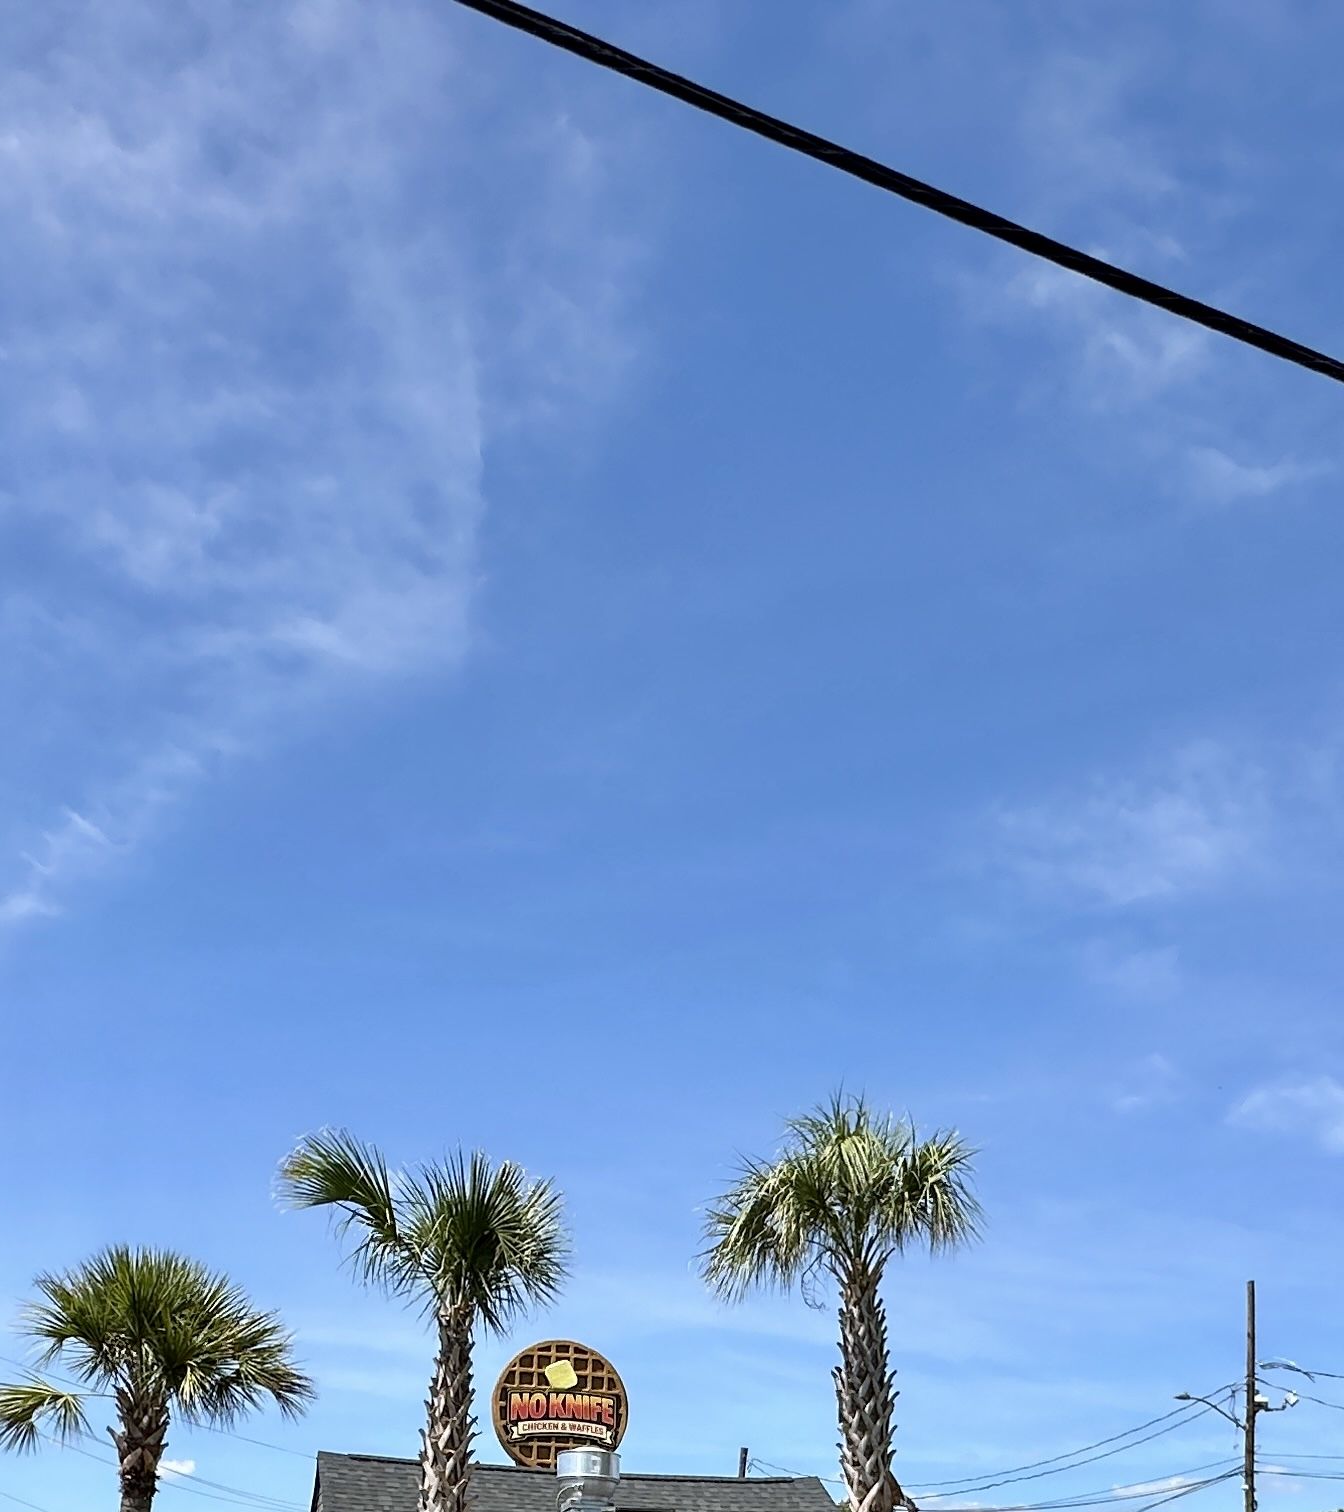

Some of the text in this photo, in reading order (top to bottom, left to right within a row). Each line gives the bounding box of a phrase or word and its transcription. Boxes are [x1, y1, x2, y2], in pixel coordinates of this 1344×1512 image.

[510, 1392, 614, 1425] NO KNIFE
[522, 1423, 560, 1432] CHICKEN
[568, 1424, 604, 1435] WAFFLES
